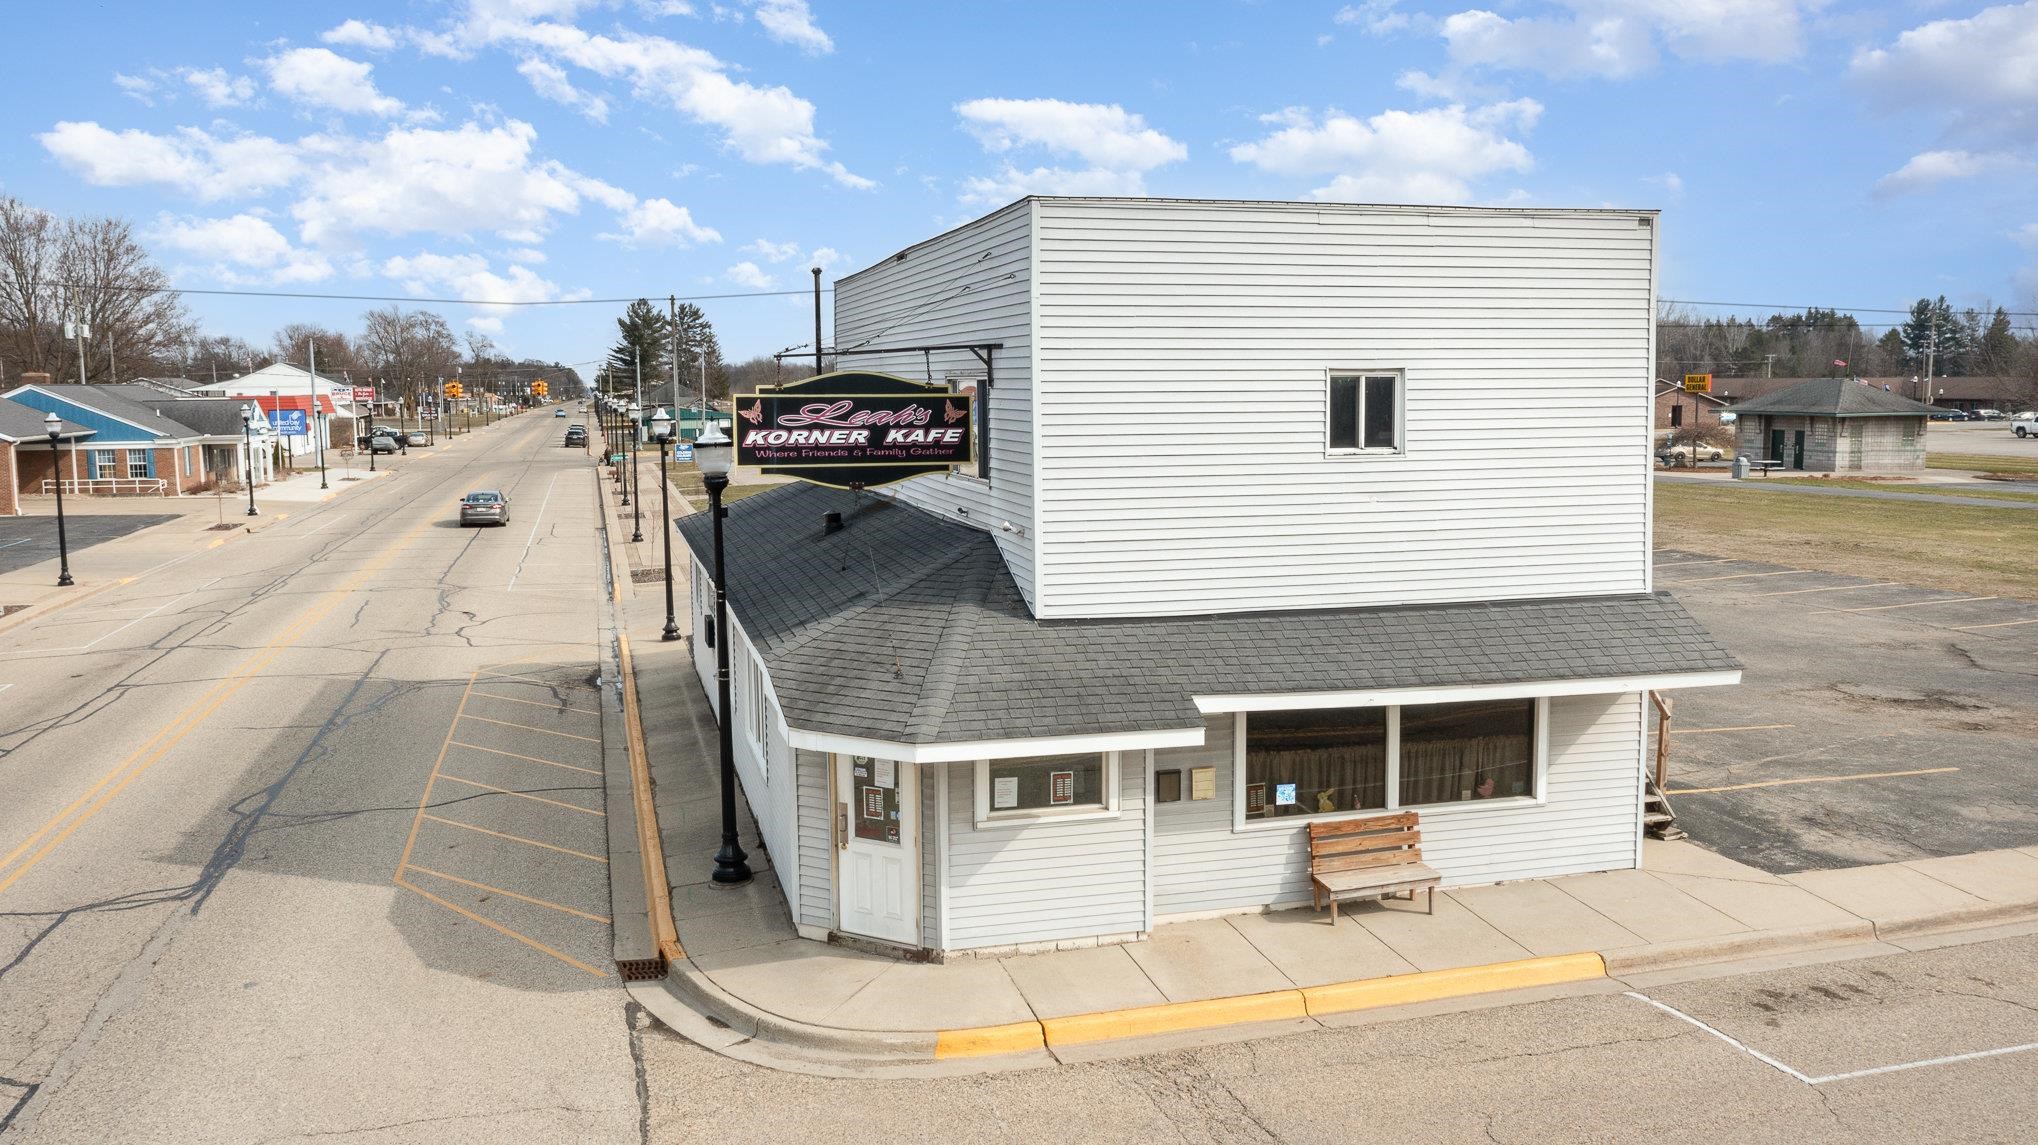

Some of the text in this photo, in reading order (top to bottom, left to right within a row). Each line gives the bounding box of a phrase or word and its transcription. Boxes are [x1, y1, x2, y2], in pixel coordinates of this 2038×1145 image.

[1688, 375, 1705, 383] DOLLAR
[777, 399, 932, 427] Leah's
[742, 427, 965, 448] KORNER KAFE
[755, 447, 956, 458] Where Friends & Family Gather
